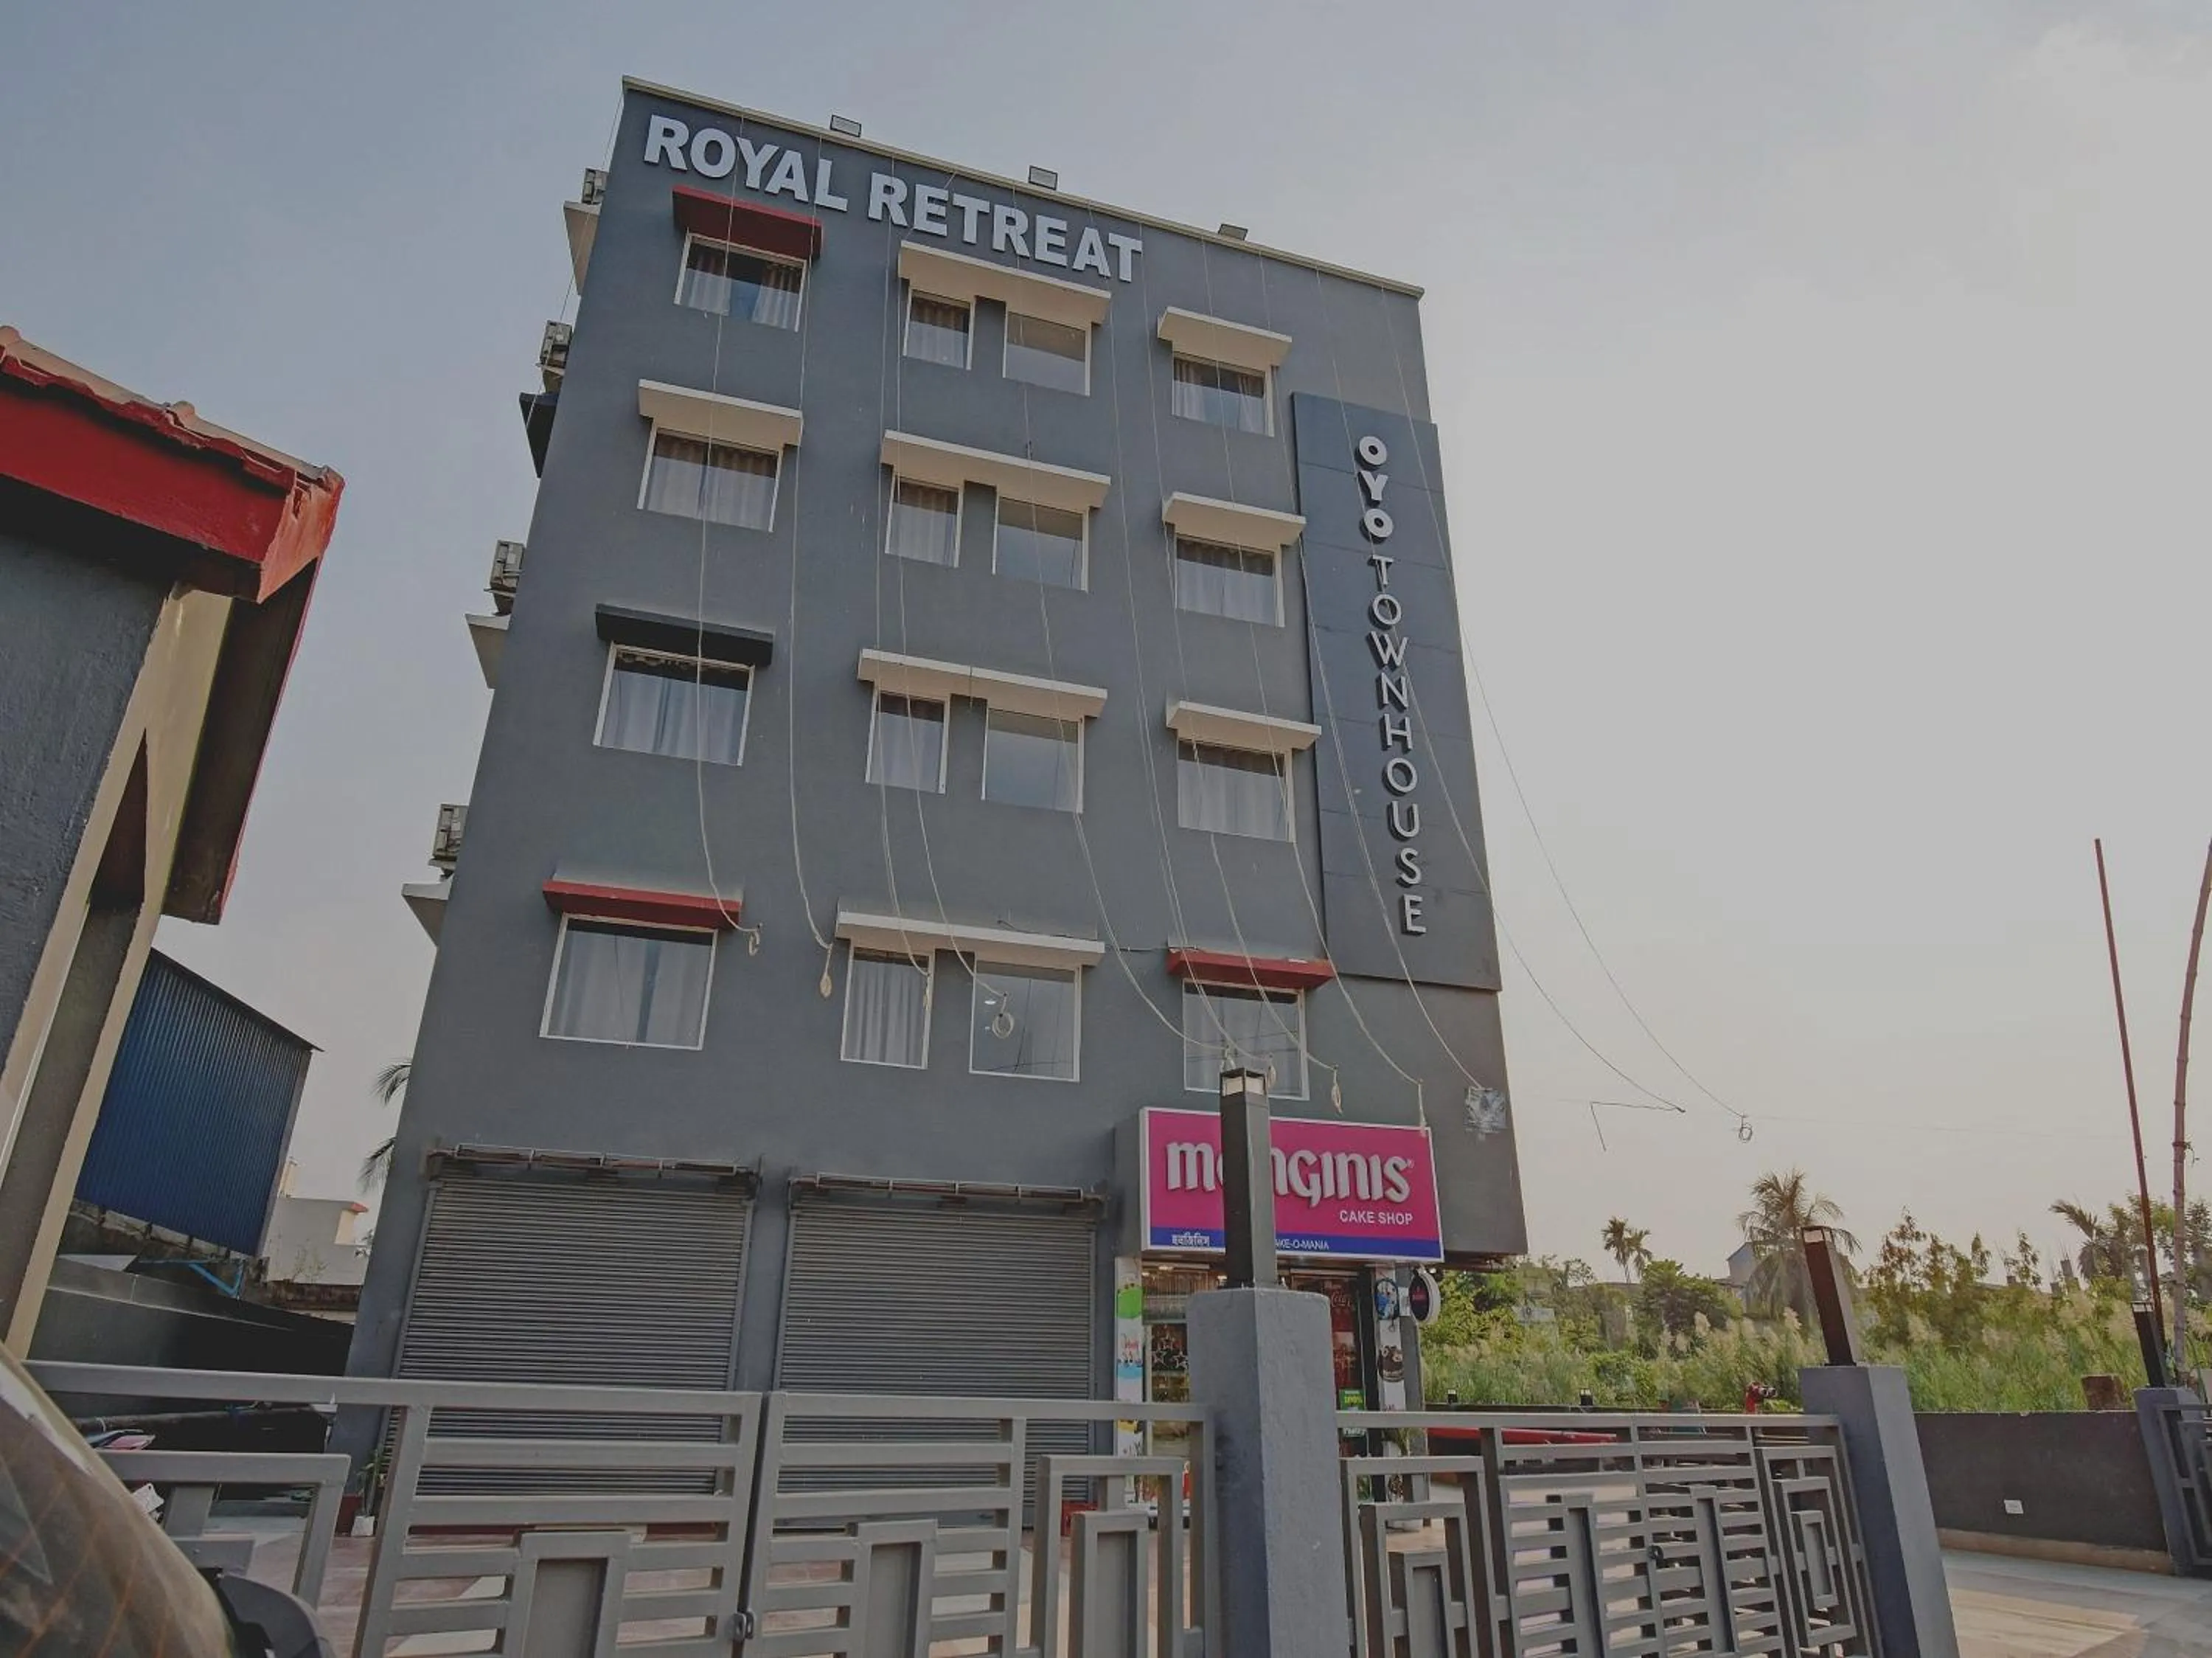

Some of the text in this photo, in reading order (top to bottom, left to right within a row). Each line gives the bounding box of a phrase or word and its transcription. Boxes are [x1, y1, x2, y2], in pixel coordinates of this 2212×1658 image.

[644, 114, 1143, 282] ROYAL RETREAT
[1358, 435, 1394, 538] OYO
[1371, 555, 1427, 934] TOWNHOUSE
[1166, 1142, 1411, 1207] mnginis
[1339, 1210, 1413, 1225] CAKE SHOP
